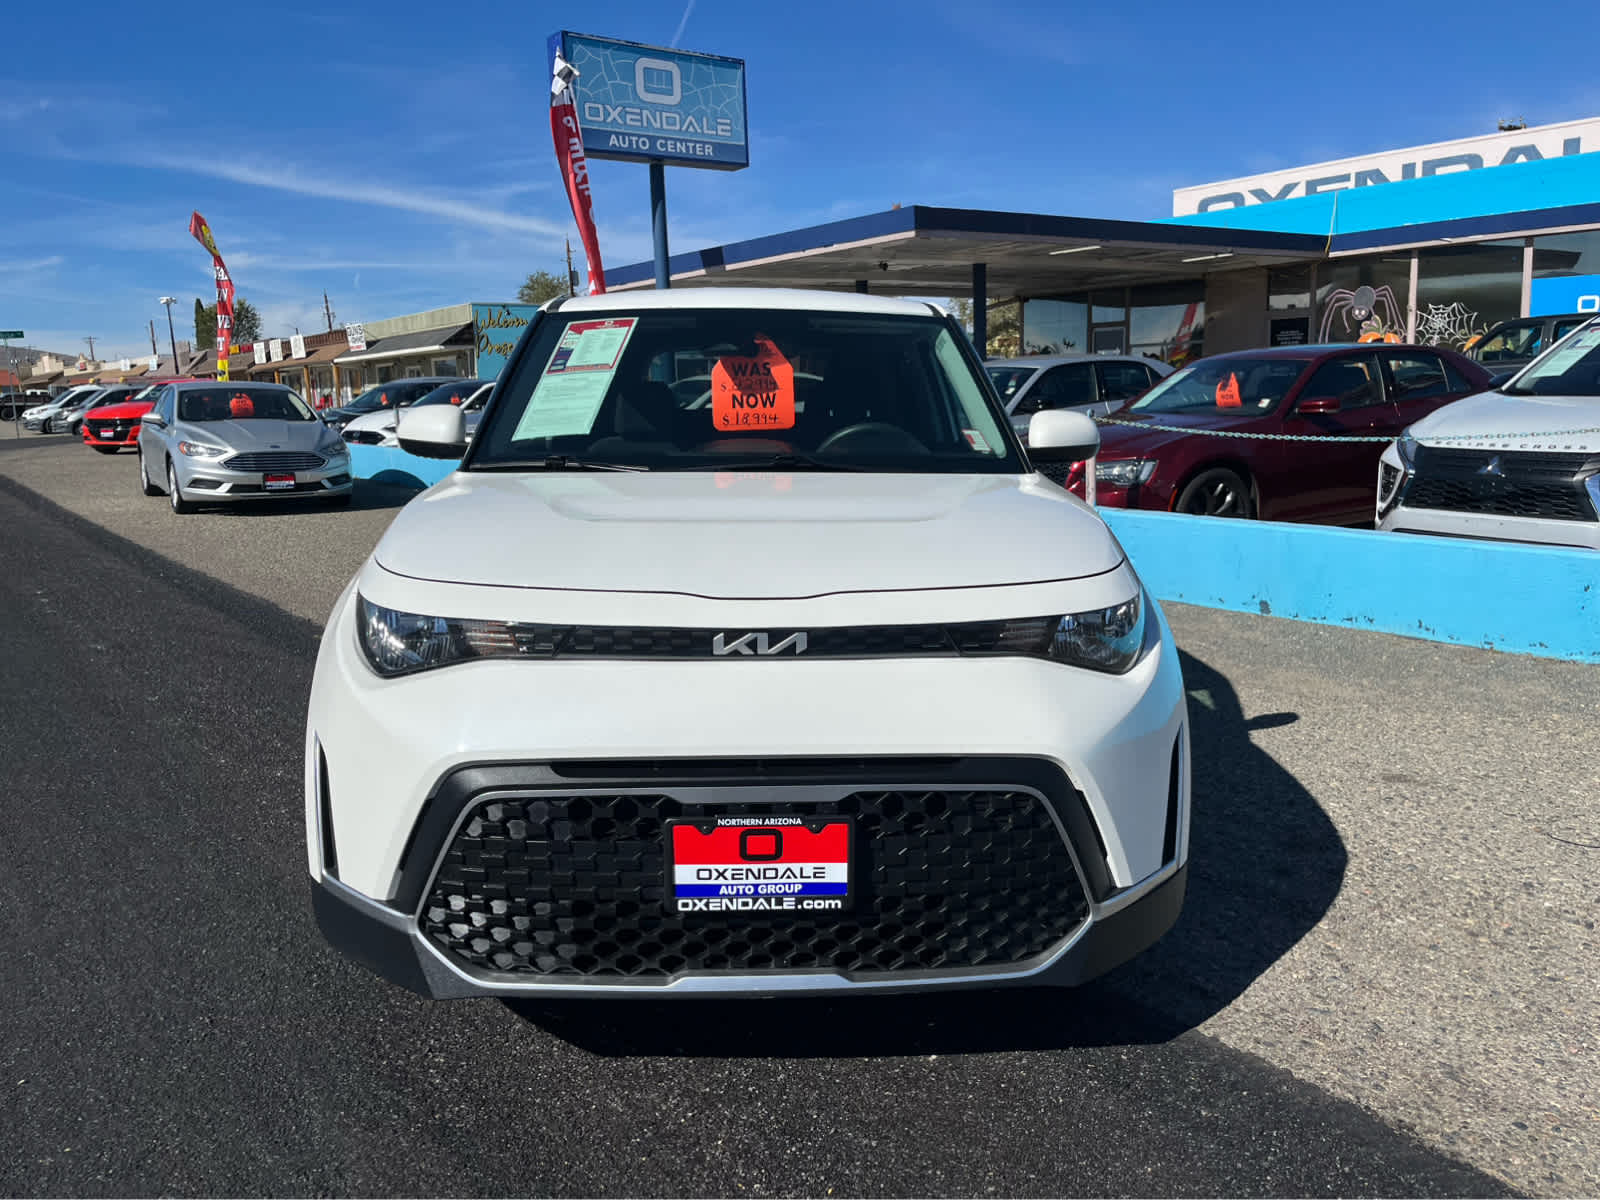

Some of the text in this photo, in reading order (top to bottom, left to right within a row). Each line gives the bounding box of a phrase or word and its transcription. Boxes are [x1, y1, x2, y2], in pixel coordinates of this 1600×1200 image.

[584, 102, 732, 137] OXENDALE
[609, 134, 714, 156] AUTO CENTER
[731, 361, 771, 377] WAS
[731, 392, 777, 409] NOW
[713, 632, 808, 656] KIA
[717, 817, 802, 826] NORTHERN ARIZONA
[696, 866, 826, 881] OXENDALE
[719, 884, 803, 896] AUTO GROUP
[677, 897, 842, 912] OXENDALE.com
